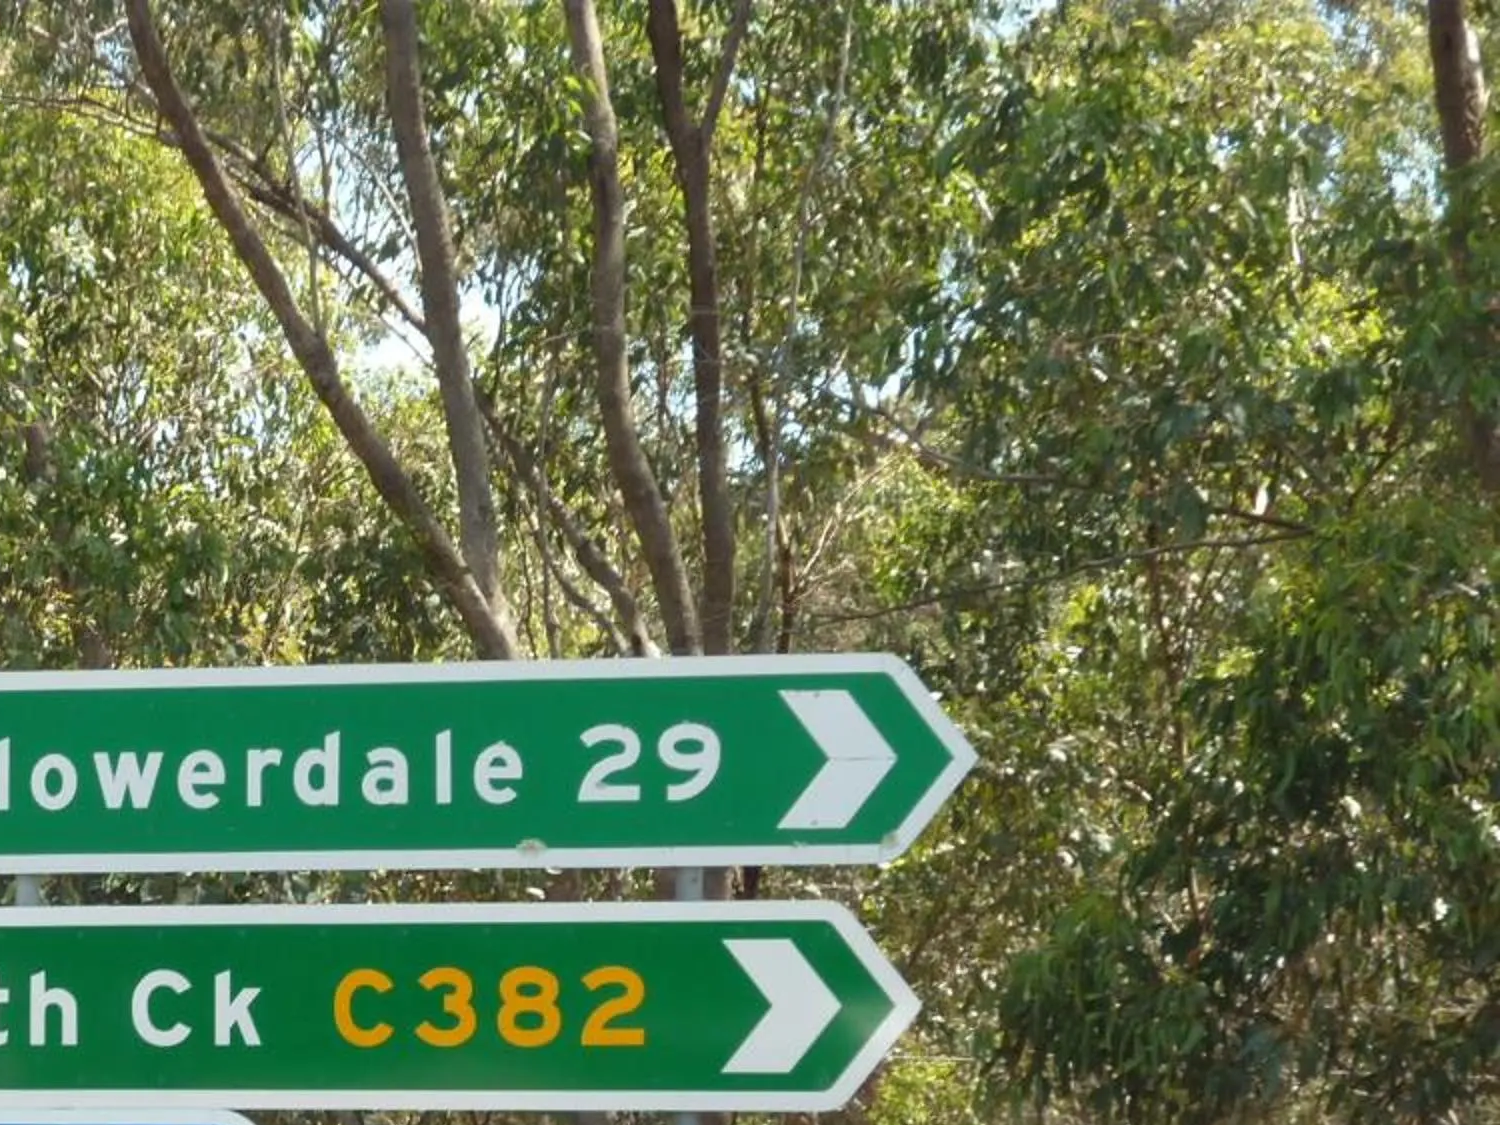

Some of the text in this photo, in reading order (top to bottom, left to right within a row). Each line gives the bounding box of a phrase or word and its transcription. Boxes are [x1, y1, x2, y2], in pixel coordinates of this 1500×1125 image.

[579, 723, 720, 801] 29
[132, 970, 260, 1046] Ck
[335, 967, 644, 1046] C382
